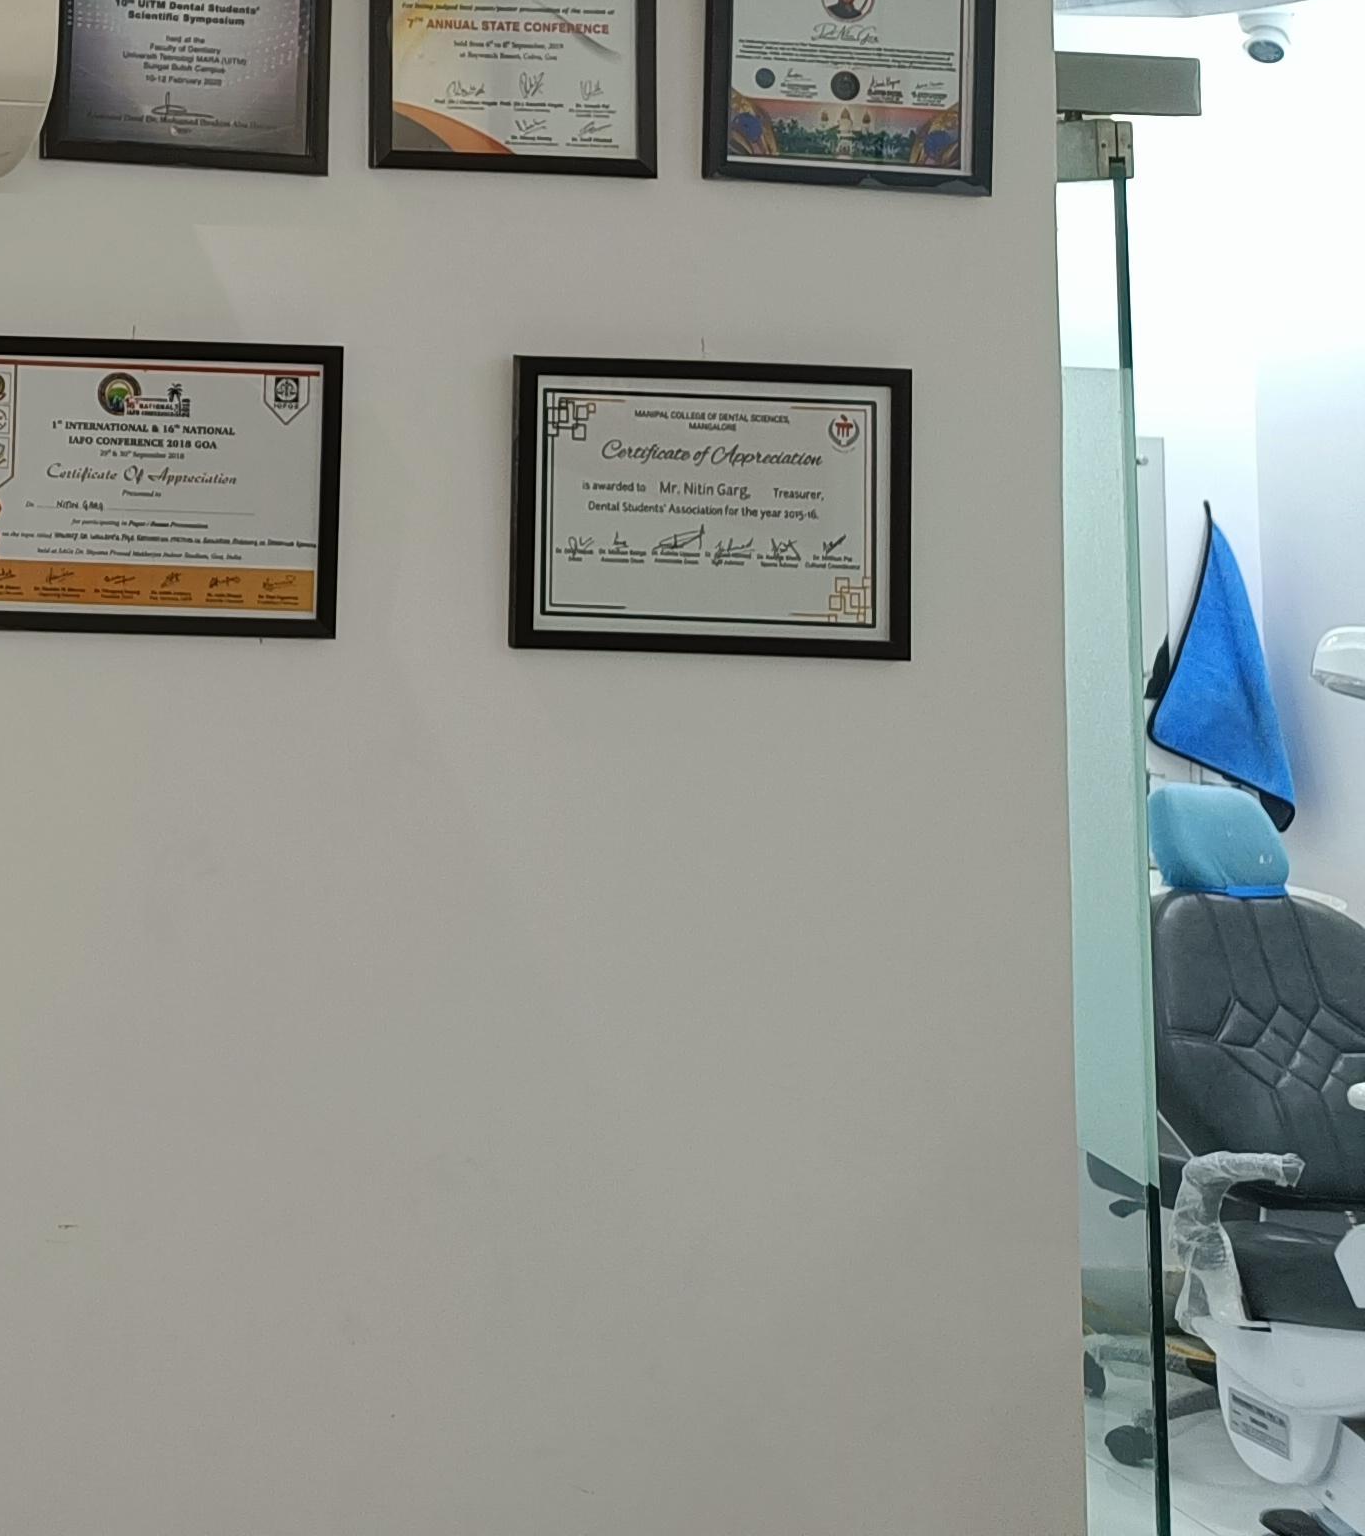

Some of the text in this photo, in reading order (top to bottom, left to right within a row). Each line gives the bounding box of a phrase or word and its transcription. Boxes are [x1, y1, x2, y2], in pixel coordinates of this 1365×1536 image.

[169, 1, 205, 11] Dental
[128, 11, 245, 26] Scientific Symposium
[427, 19, 609, 34] ANNUAL STATE CONFERENCE
[635, 410, 749, 422] MANIPAL COLLEGE OF DENTAL
[65, 421, 148, 432] INTERNATIONAL
[183, 425, 235, 435] NATIONAL
[689, 423, 736, 431] MANGALORE
[69, 436, 217, 449] IAFO CONFERENCE 2018 GOA
[602, 439, 823, 468] Certificate of Appreciation
[46, 463, 237, 485] Certificate Of Appreciation
[582, 481, 824, 501] is awarded to Mr. Nitin Garg, Treasurer,
[588, 501, 781, 520] Dental Students' Association for the year
